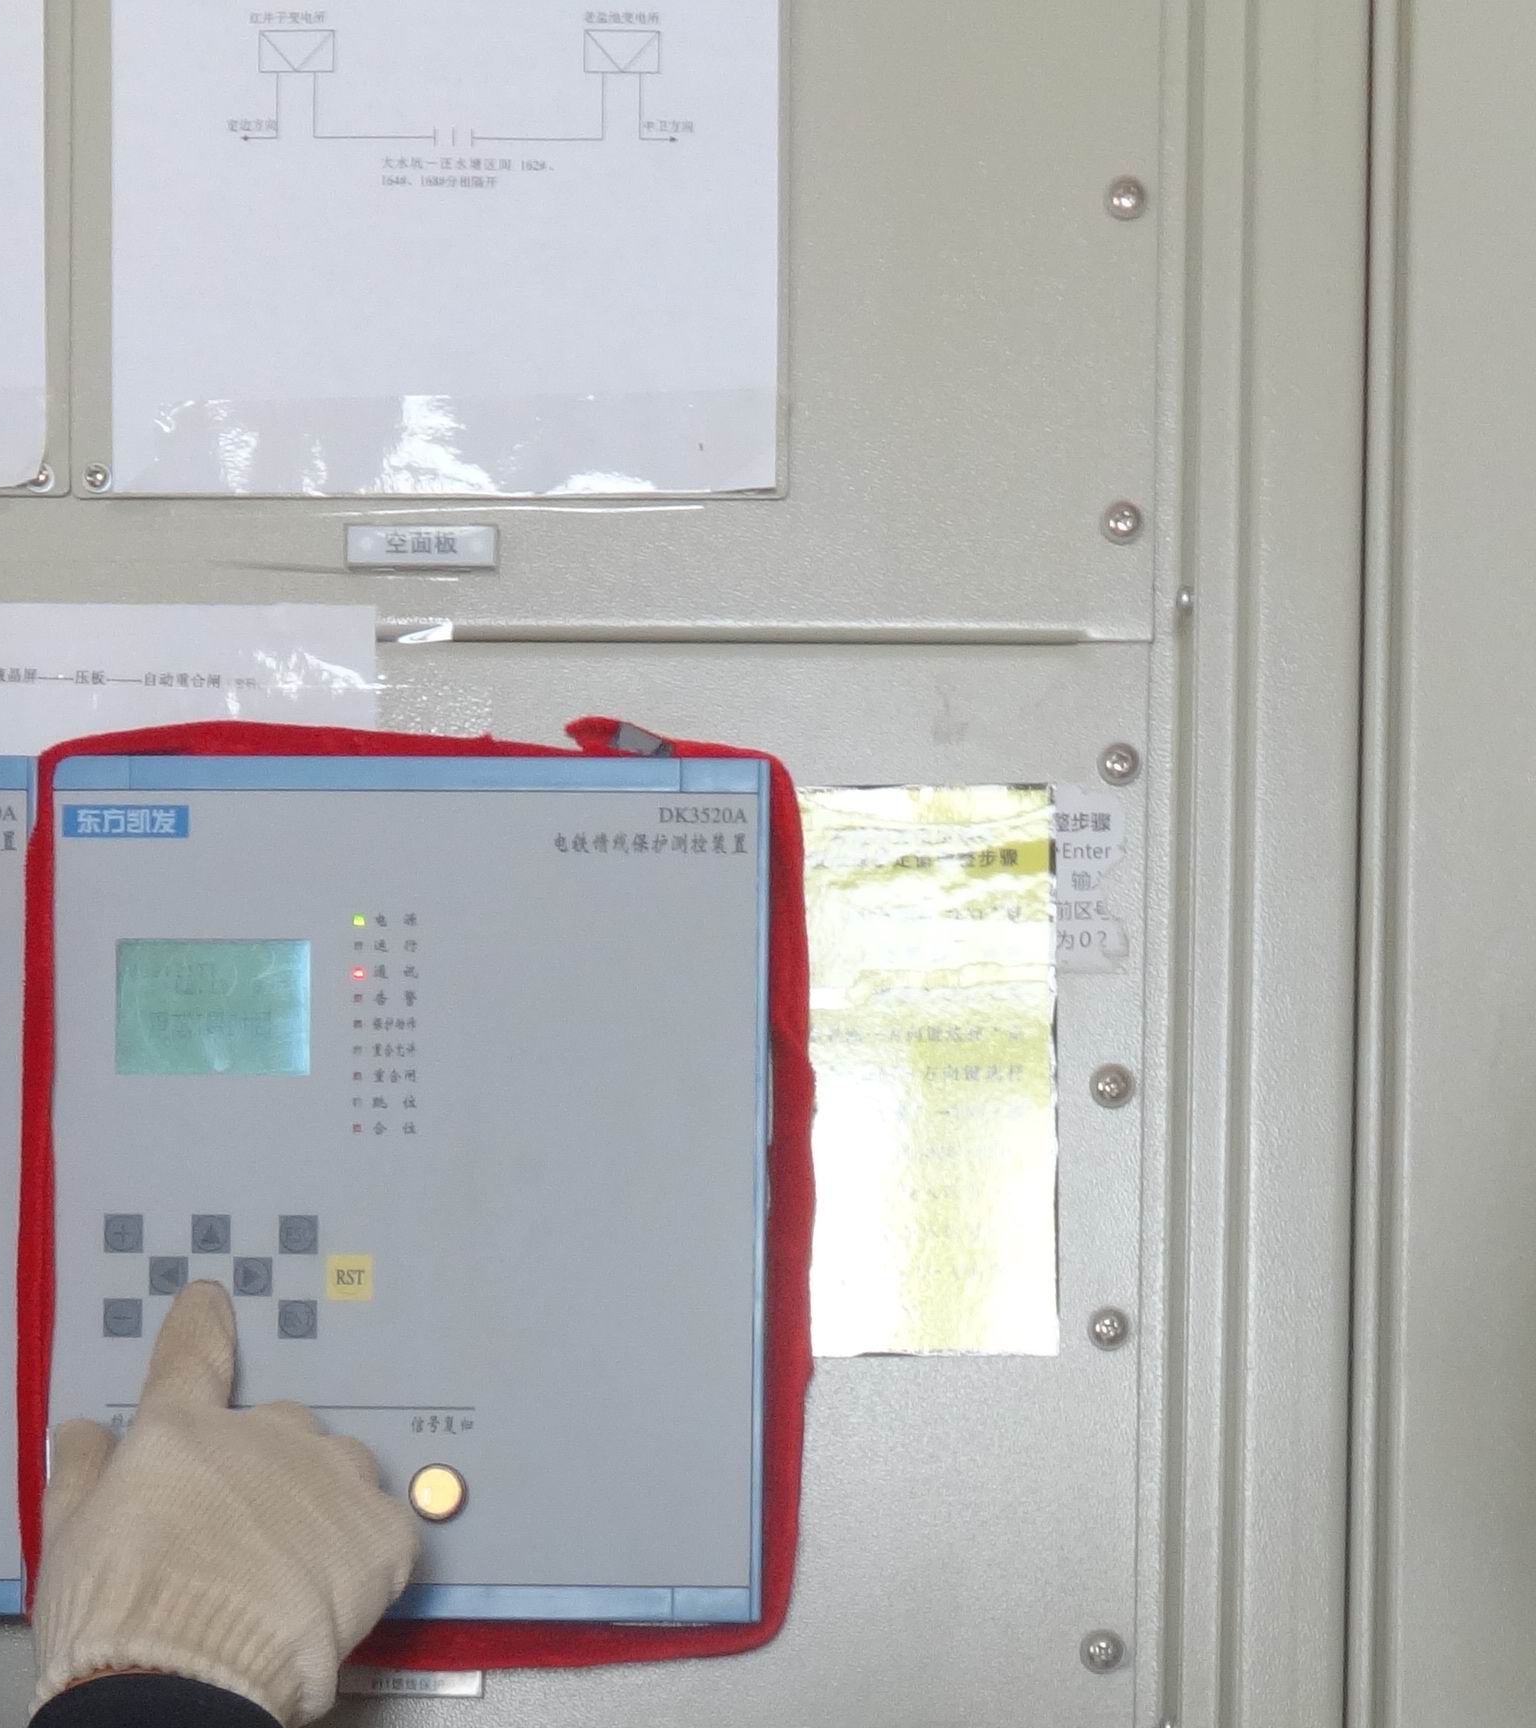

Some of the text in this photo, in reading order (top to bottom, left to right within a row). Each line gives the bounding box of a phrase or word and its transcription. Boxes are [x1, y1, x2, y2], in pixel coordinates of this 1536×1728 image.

[384, 531, 459, 556] 空面板
[75, 807, 178, 834] 东方凯发
[657, 806, 749, 826] DK3520A
[553, 831, 749, 856] 电铁馈线保护测控装置
[1062, 842, 1112, 860] Enter
[374, 912, 418, 928] 电源
[334, 1268, 366, 1287] RST
